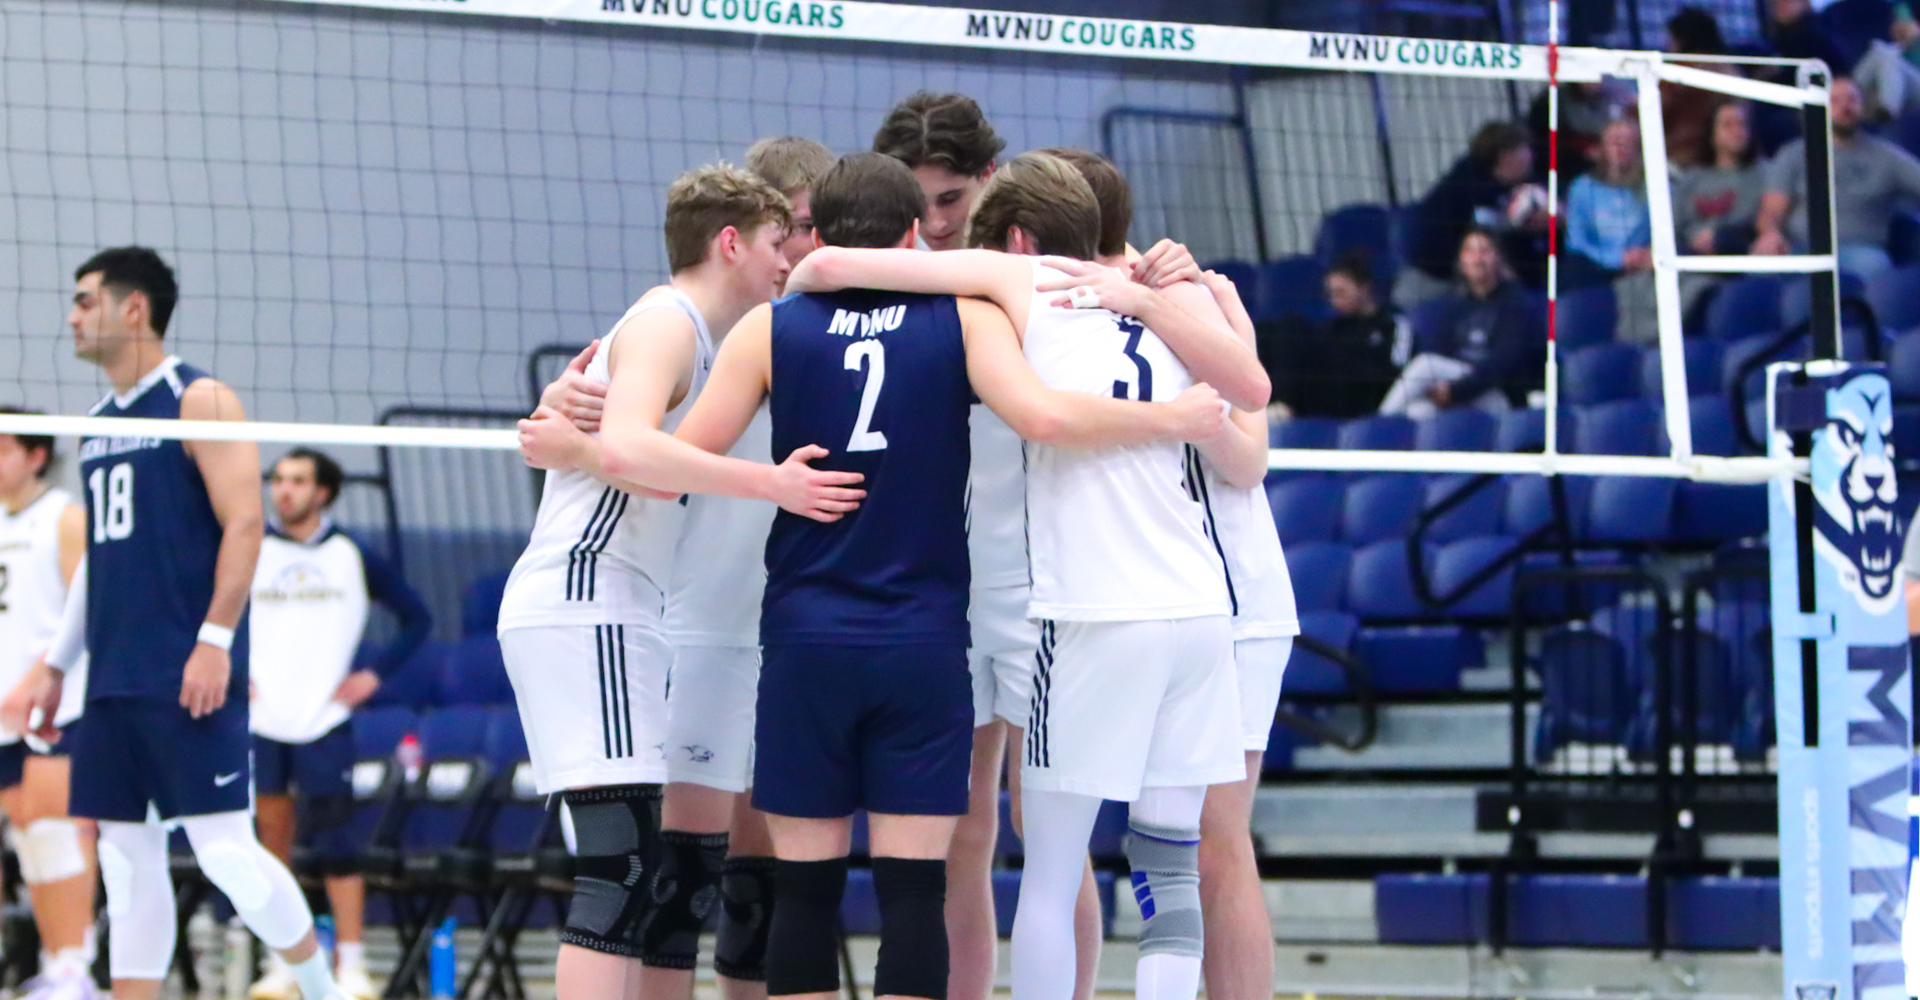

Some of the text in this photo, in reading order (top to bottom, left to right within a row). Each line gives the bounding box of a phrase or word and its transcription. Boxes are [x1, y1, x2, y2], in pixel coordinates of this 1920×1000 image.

[701, 0, 844, 28] COUGARS
[966, 14, 1195, 50] MVNU COUGARS
[1309, 36, 1521, 69] MVNU COUGARS
[826, 304, 907, 338] MVNU
[1112, 323, 1153, 402] 3
[843, 339, 888, 452] 2
[89, 462, 134, 544] 18
